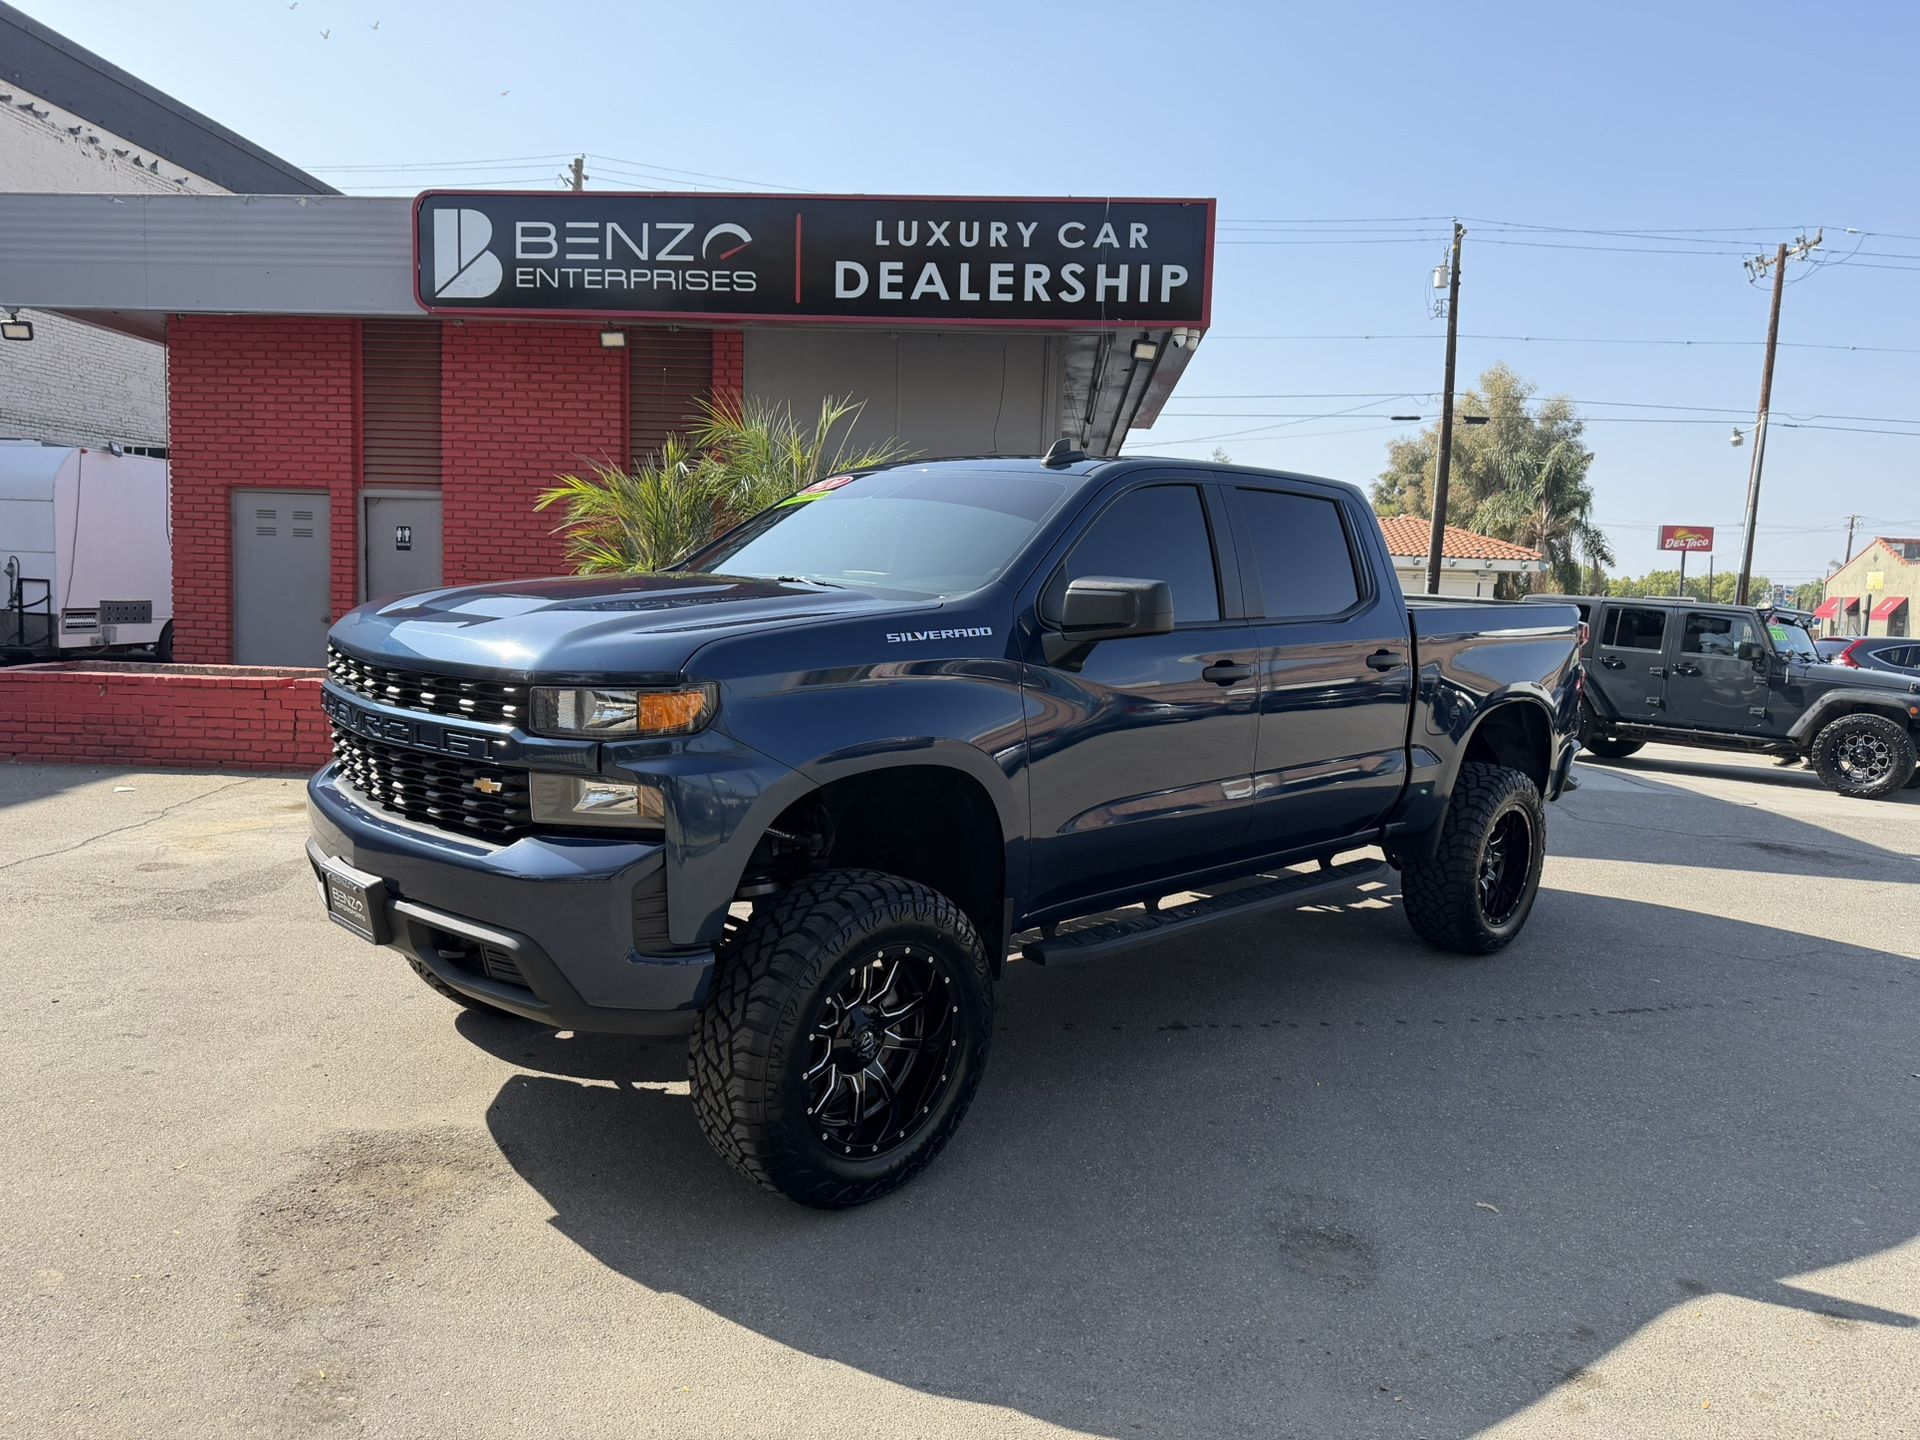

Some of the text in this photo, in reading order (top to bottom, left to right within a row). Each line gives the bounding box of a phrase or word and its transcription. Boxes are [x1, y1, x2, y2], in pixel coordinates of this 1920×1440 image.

[515, 221, 753, 261] BENZO
[875, 220, 1149, 249] LUXURY CAR
[516, 267, 757, 293] ENTERPRISES
[834, 260, 1189, 303] DEALERSHIP
[885, 626, 993, 643] SILVERADO
